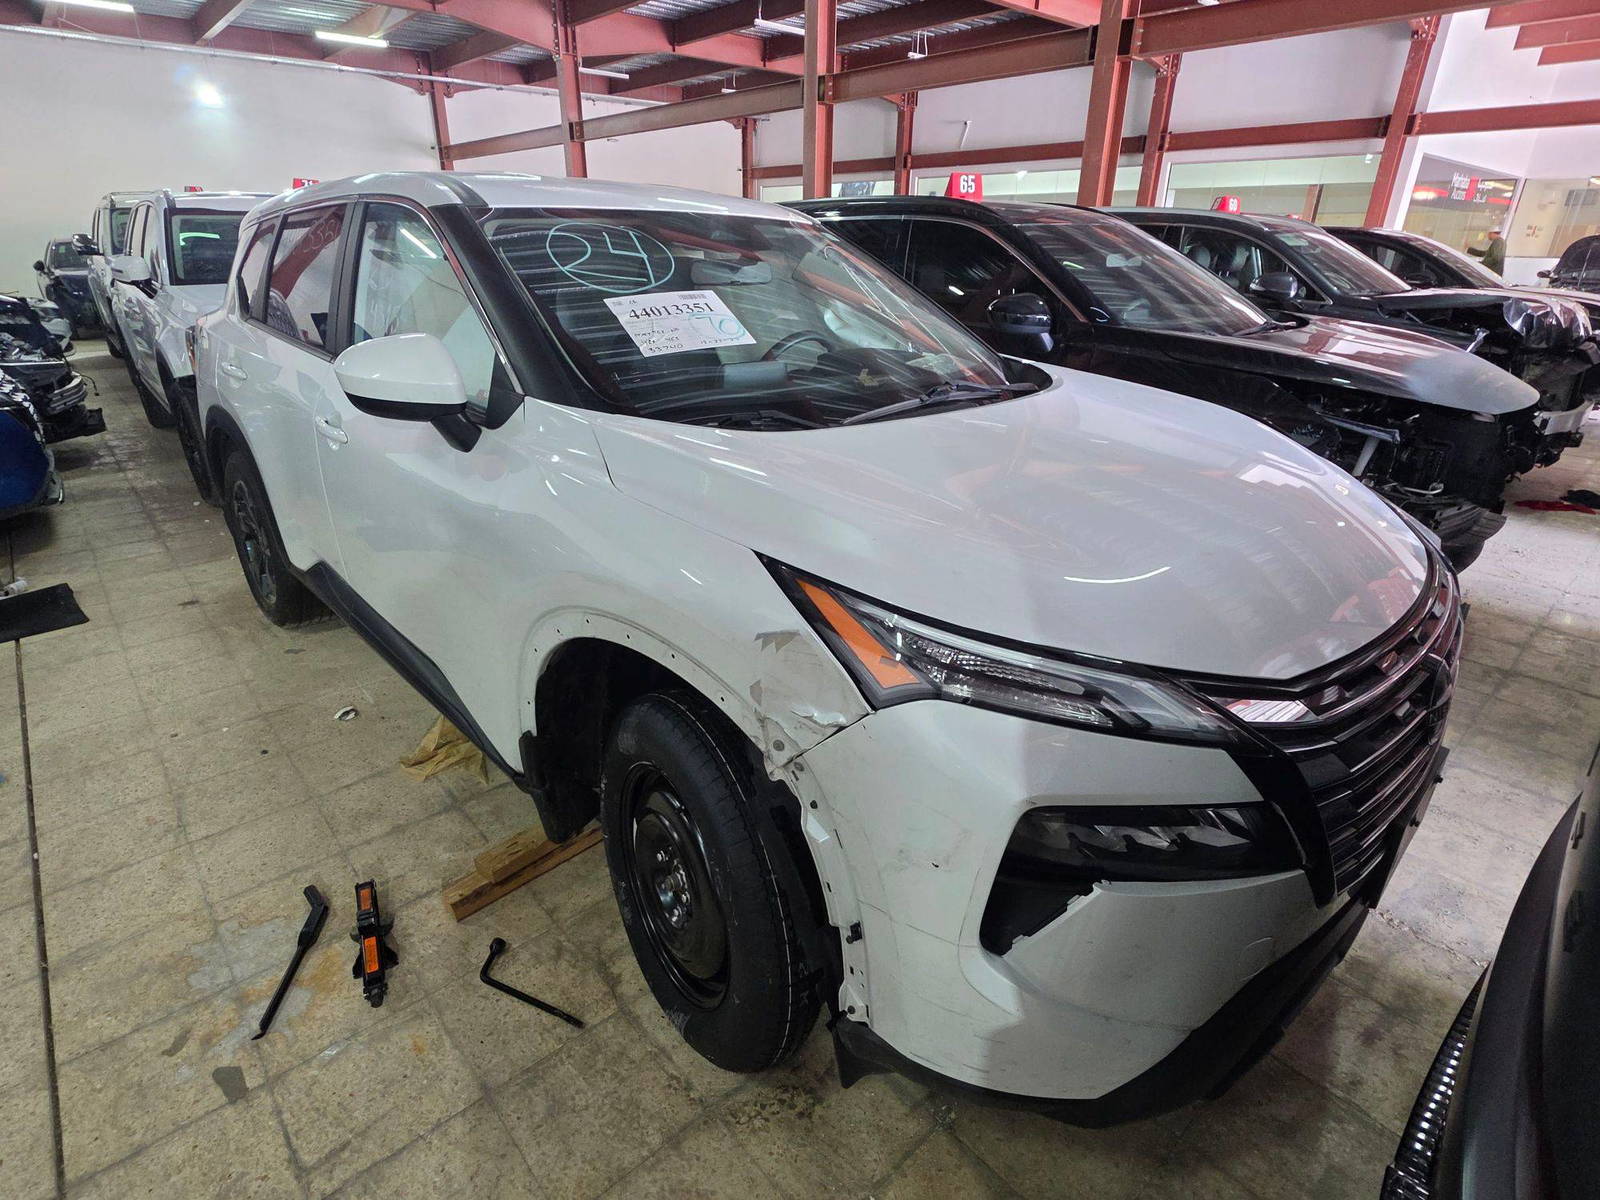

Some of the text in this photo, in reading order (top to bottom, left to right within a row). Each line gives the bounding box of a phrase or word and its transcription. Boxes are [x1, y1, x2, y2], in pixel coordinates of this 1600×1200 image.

[960, 175, 976, 193] 65
[549, 230, 656, 285] 24
[629, 302, 714, 319] 44013351
